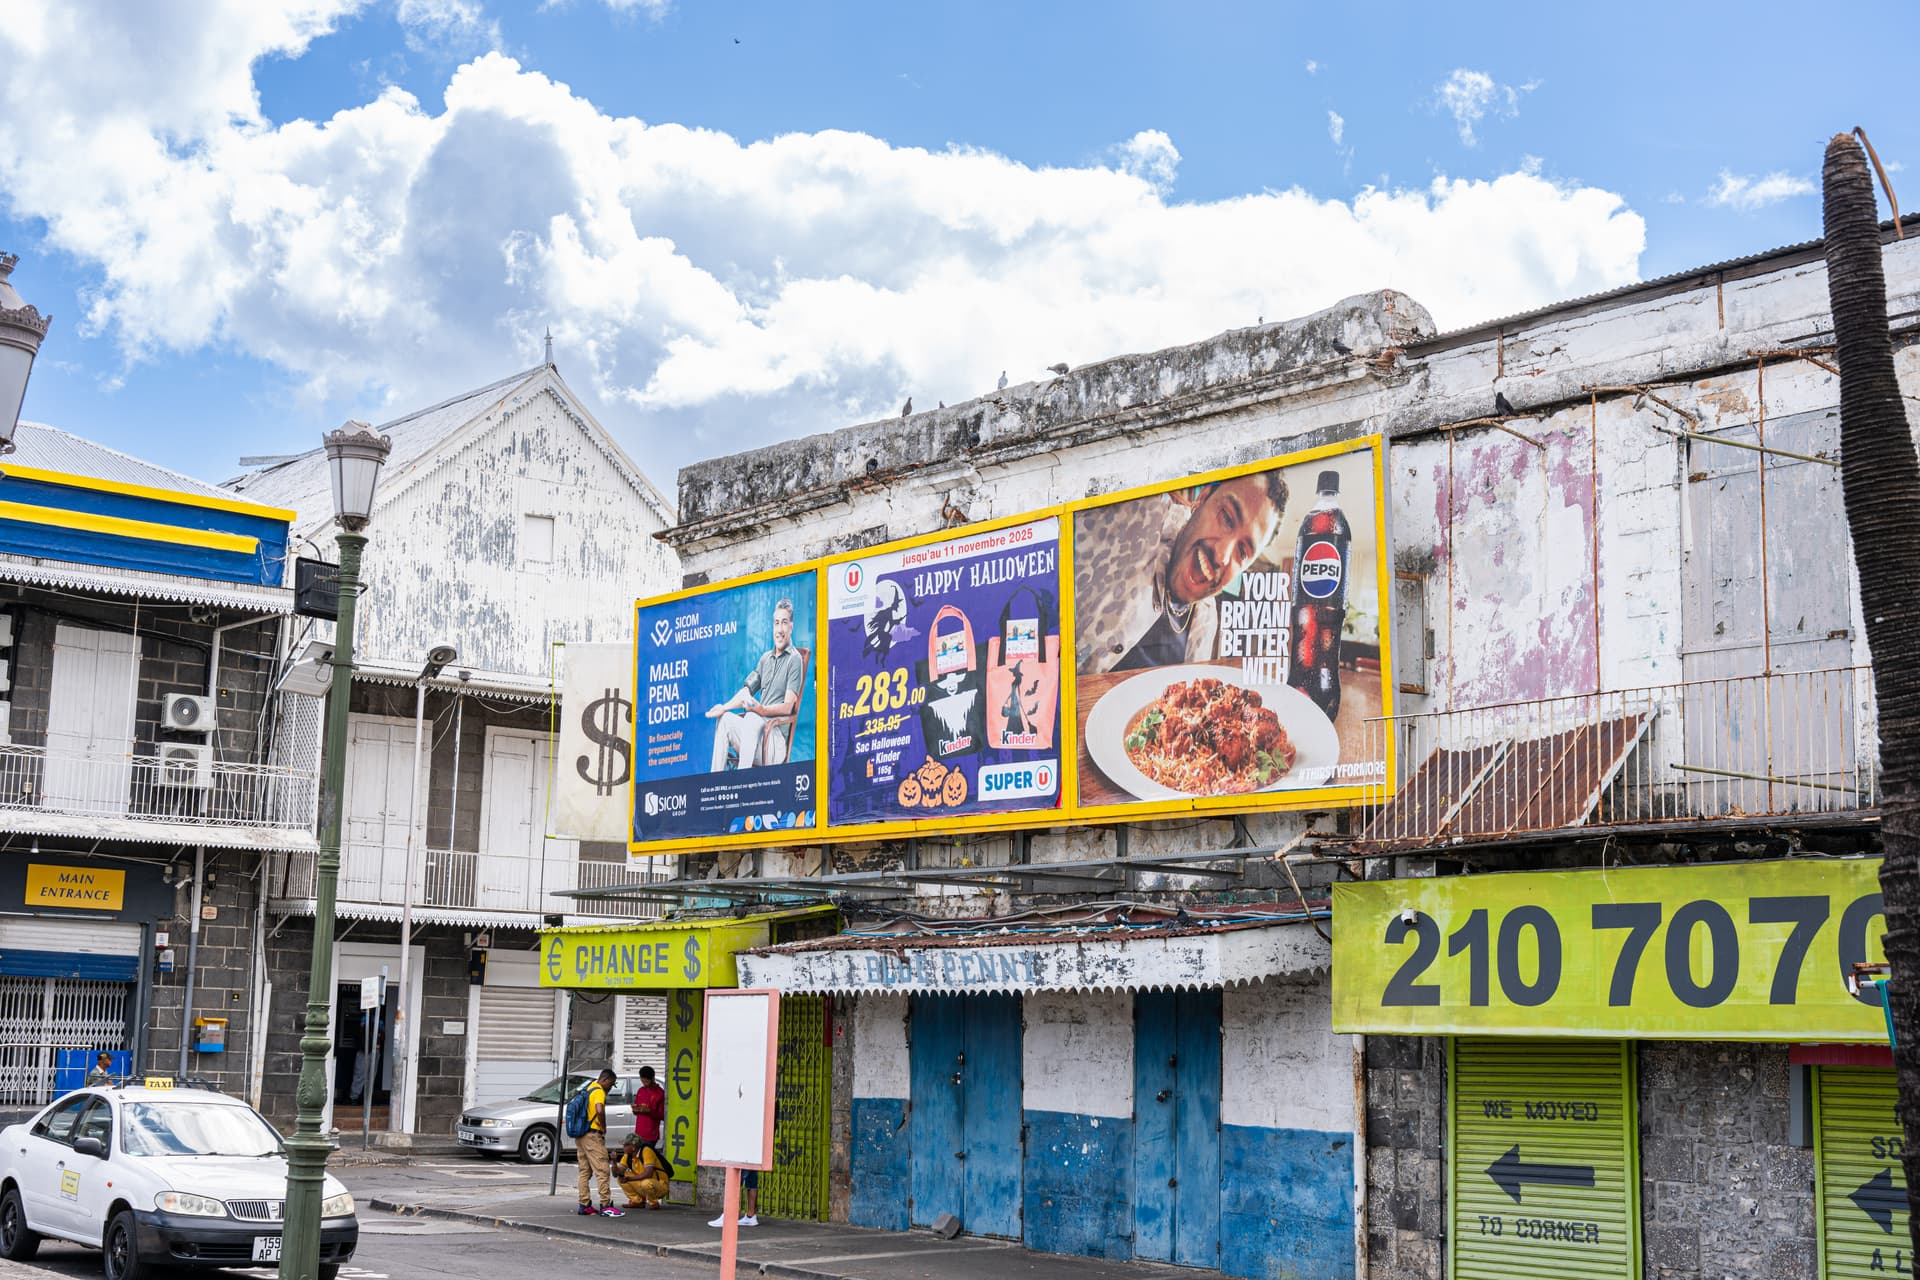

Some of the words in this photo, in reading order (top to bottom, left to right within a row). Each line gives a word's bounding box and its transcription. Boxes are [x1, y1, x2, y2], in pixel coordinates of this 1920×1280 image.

[902, 549, 941, 567] jusqu'au
[944, 545, 954, 557] 11
[958, 536, 1005, 554] novembre
[1009, 528, 1033, 544] 2025
[914, 566, 964, 597] HAPPY
[970, 548, 1055, 587] HALLOWEEN
[1302, 563, 1339, 577] PEPSI
[1242, 572, 1290, 601] YOUR
[675, 612, 699, 629] SICOM
[1220, 601, 1291, 629] BRIYANI
[674, 625, 713, 644] WELLNESS
[715, 621, 737, 637] PLAN
[1220, 628, 1289, 657] BETTER
[649, 659, 689, 682] MALER
[1242, 657, 1289, 685] WITH
[649, 683, 680, 704] PENA
[648, 701, 689, 725] LODERI
[649, 735, 656, 744] Be
[657, 730, 683, 743] financially
[855, 741, 869, 754] Sac
[871, 735, 911, 751] Halloween
[649, 743, 672, 757] prepared
[876, 750, 901, 765] Kinder
[649, 758, 657, 766] the
[795, 774, 810, 792] 50
[985, 770, 1032, 792] SUPER
[658, 794, 687, 812] SICOM
[58, 873, 94, 885] MAIN
[40, 886, 110, 901] ENTRANCE
[1381, 904, 1562, 1007] 210
[942, 951, 1034, 986] PENNY
[1482, 1100, 1512, 1119] WE
[1524, 1101, 1599, 1121] MOVED
[1478, 1215, 1503, 1236] TO
[1516, 1218, 1600, 1244] CORNER
[259, 1249, 271, 1260] AP
[1870, 1248, 1885, 1272] A
